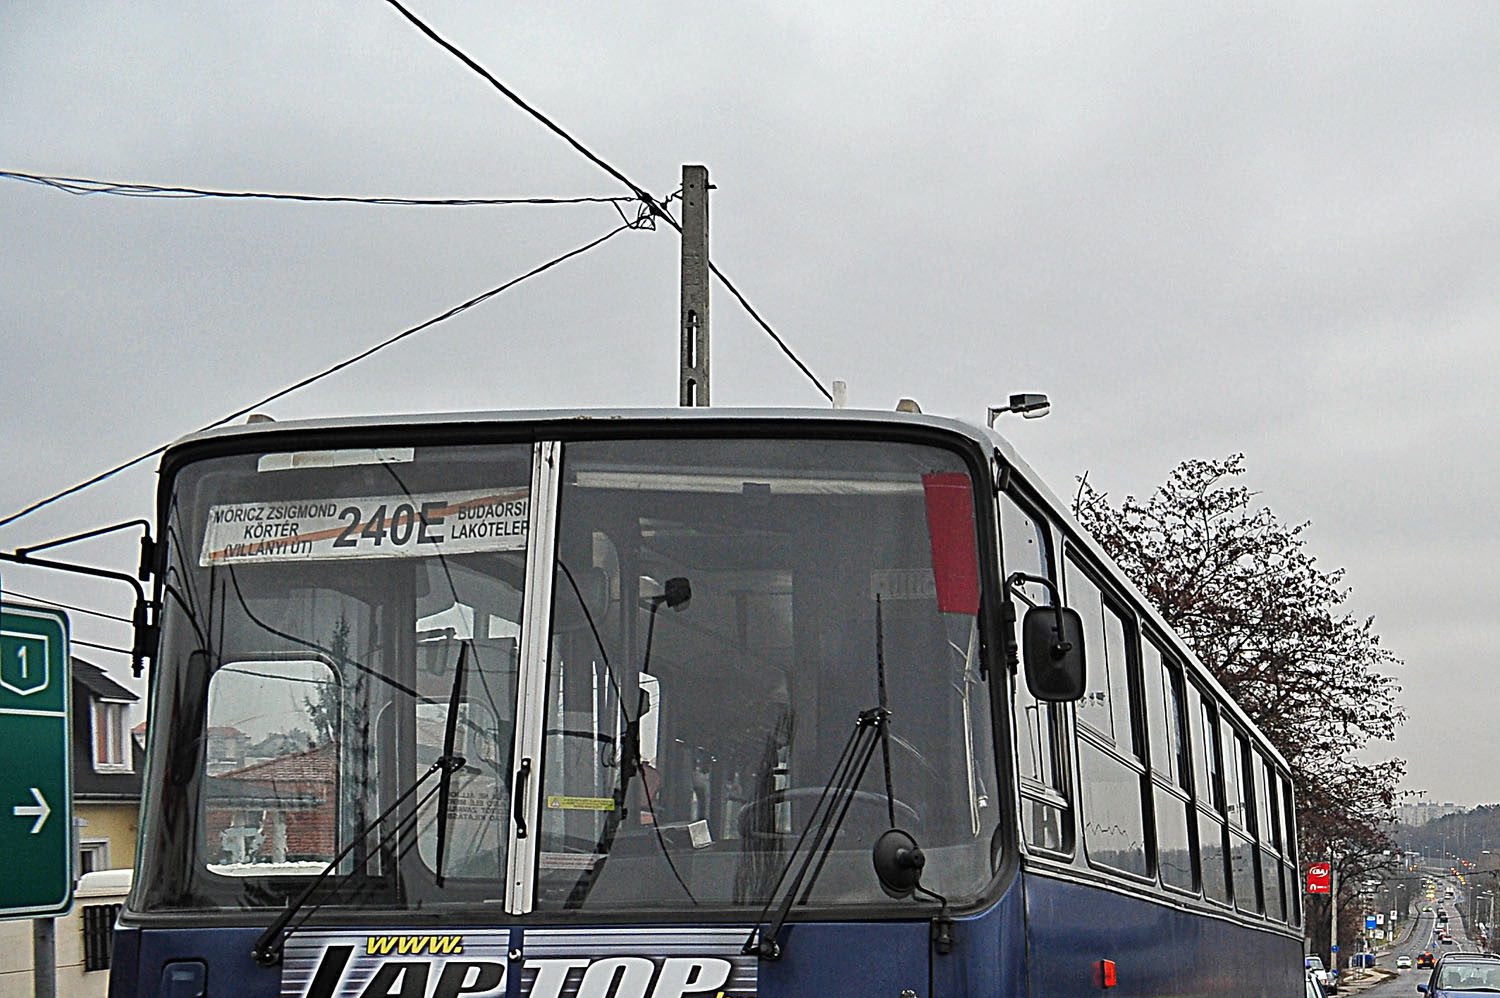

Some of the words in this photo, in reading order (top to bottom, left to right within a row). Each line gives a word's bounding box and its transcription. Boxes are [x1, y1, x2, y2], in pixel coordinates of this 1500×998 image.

[213, 505, 264, 523] MÓRICZ
[266, 504, 337, 520] ZSIGMOND
[244, 520, 299, 539] KÖRTÉR
[332, 501, 449, 547] 240E
[18, 646, 27, 678] 1
[366, 935, 463, 955] www.
